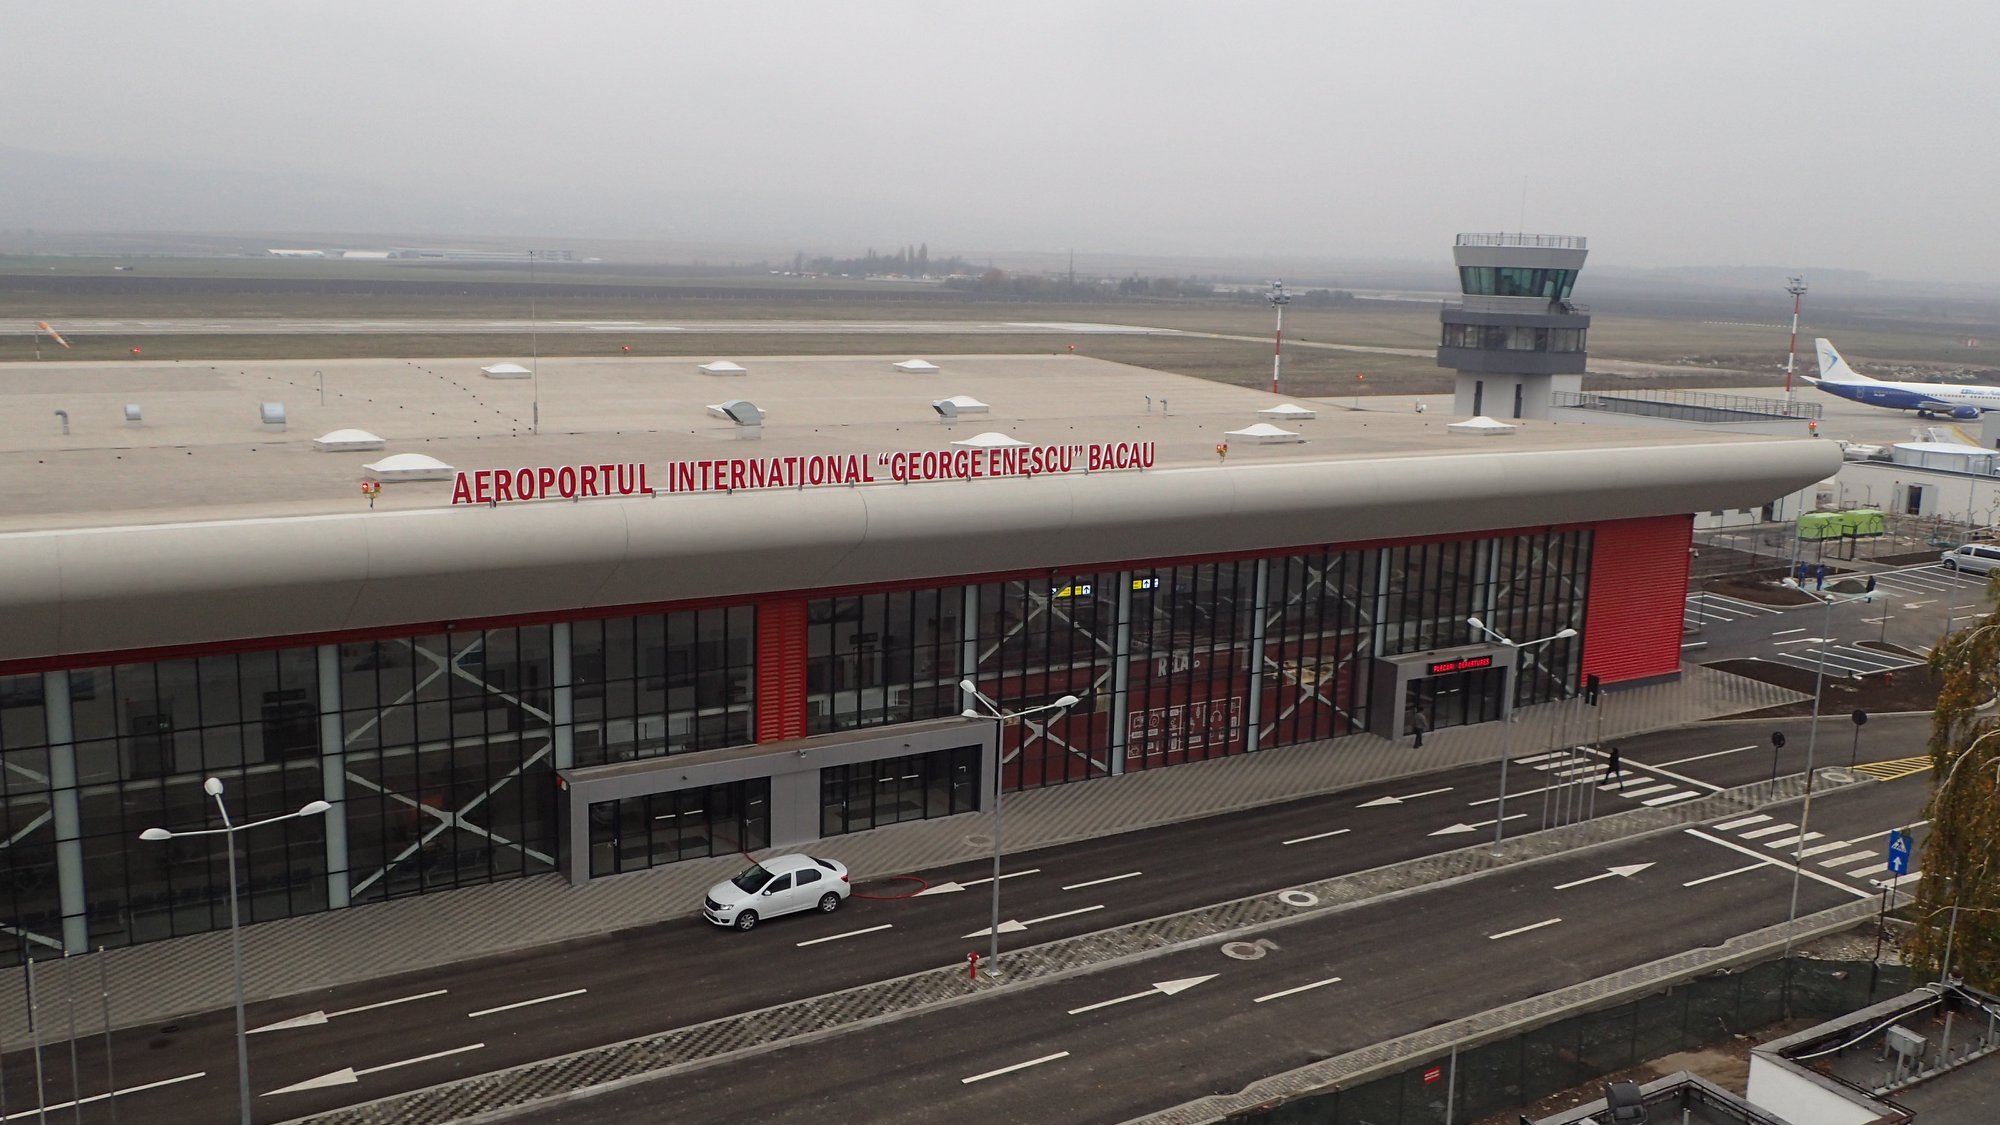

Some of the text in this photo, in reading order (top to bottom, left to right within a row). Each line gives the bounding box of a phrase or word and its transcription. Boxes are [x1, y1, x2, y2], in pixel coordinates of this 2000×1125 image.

[451, 441, 1155, 504] AEROPORTUL INTERNATIONAL “GEORGE ENESCU” BACAU
